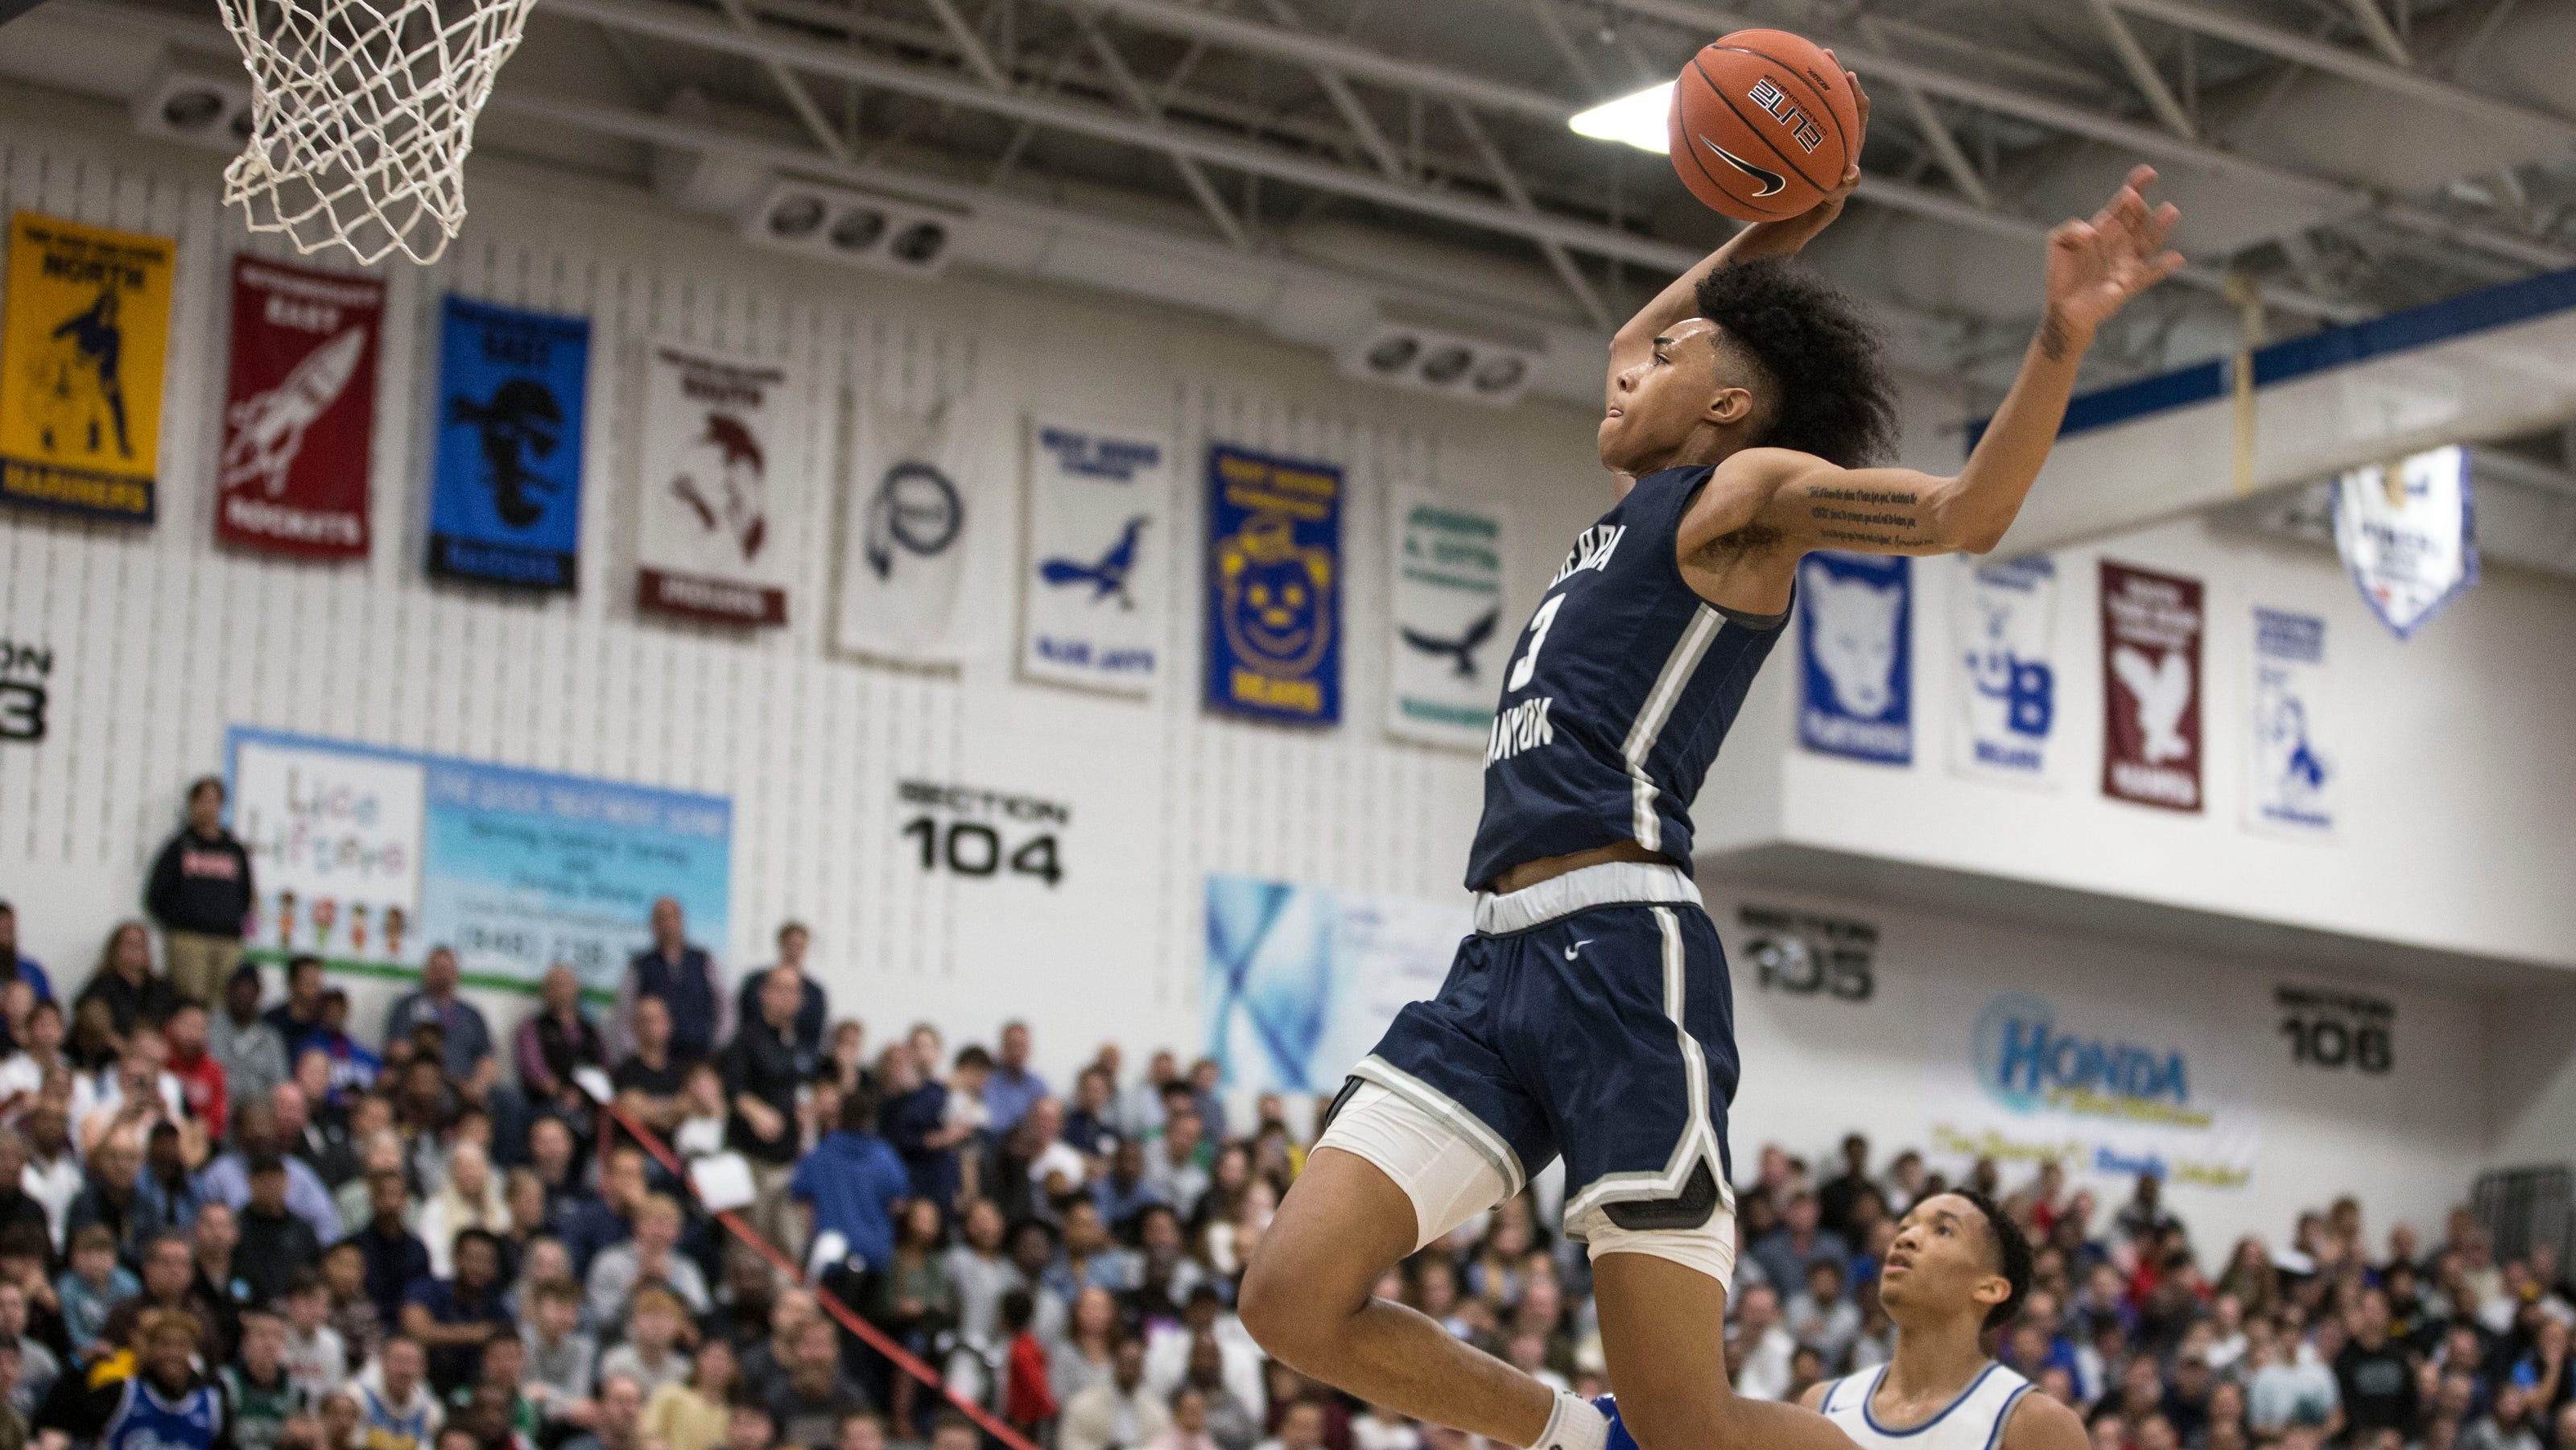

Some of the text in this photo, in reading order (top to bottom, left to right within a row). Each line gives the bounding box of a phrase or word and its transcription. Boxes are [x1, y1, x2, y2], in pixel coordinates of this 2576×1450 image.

[1748, 78, 1824, 155] ELITE
[1765, 74, 1828, 136] CHAMPIONSHIP
[44, 253, 145, 290] NORTH
[1509, 593, 1566, 692] 3
[284, 765, 380, 827] Lice
[898, 780, 1071, 824] SECTION
[902, 816, 1063, 890] 104
[1738, 905, 1880, 946] SECTION
[2275, 982, 2397, 1020] SECTION
[1998, 1016, 2186, 1105] HONDA
[2279, 1015, 2395, 1075] 106
